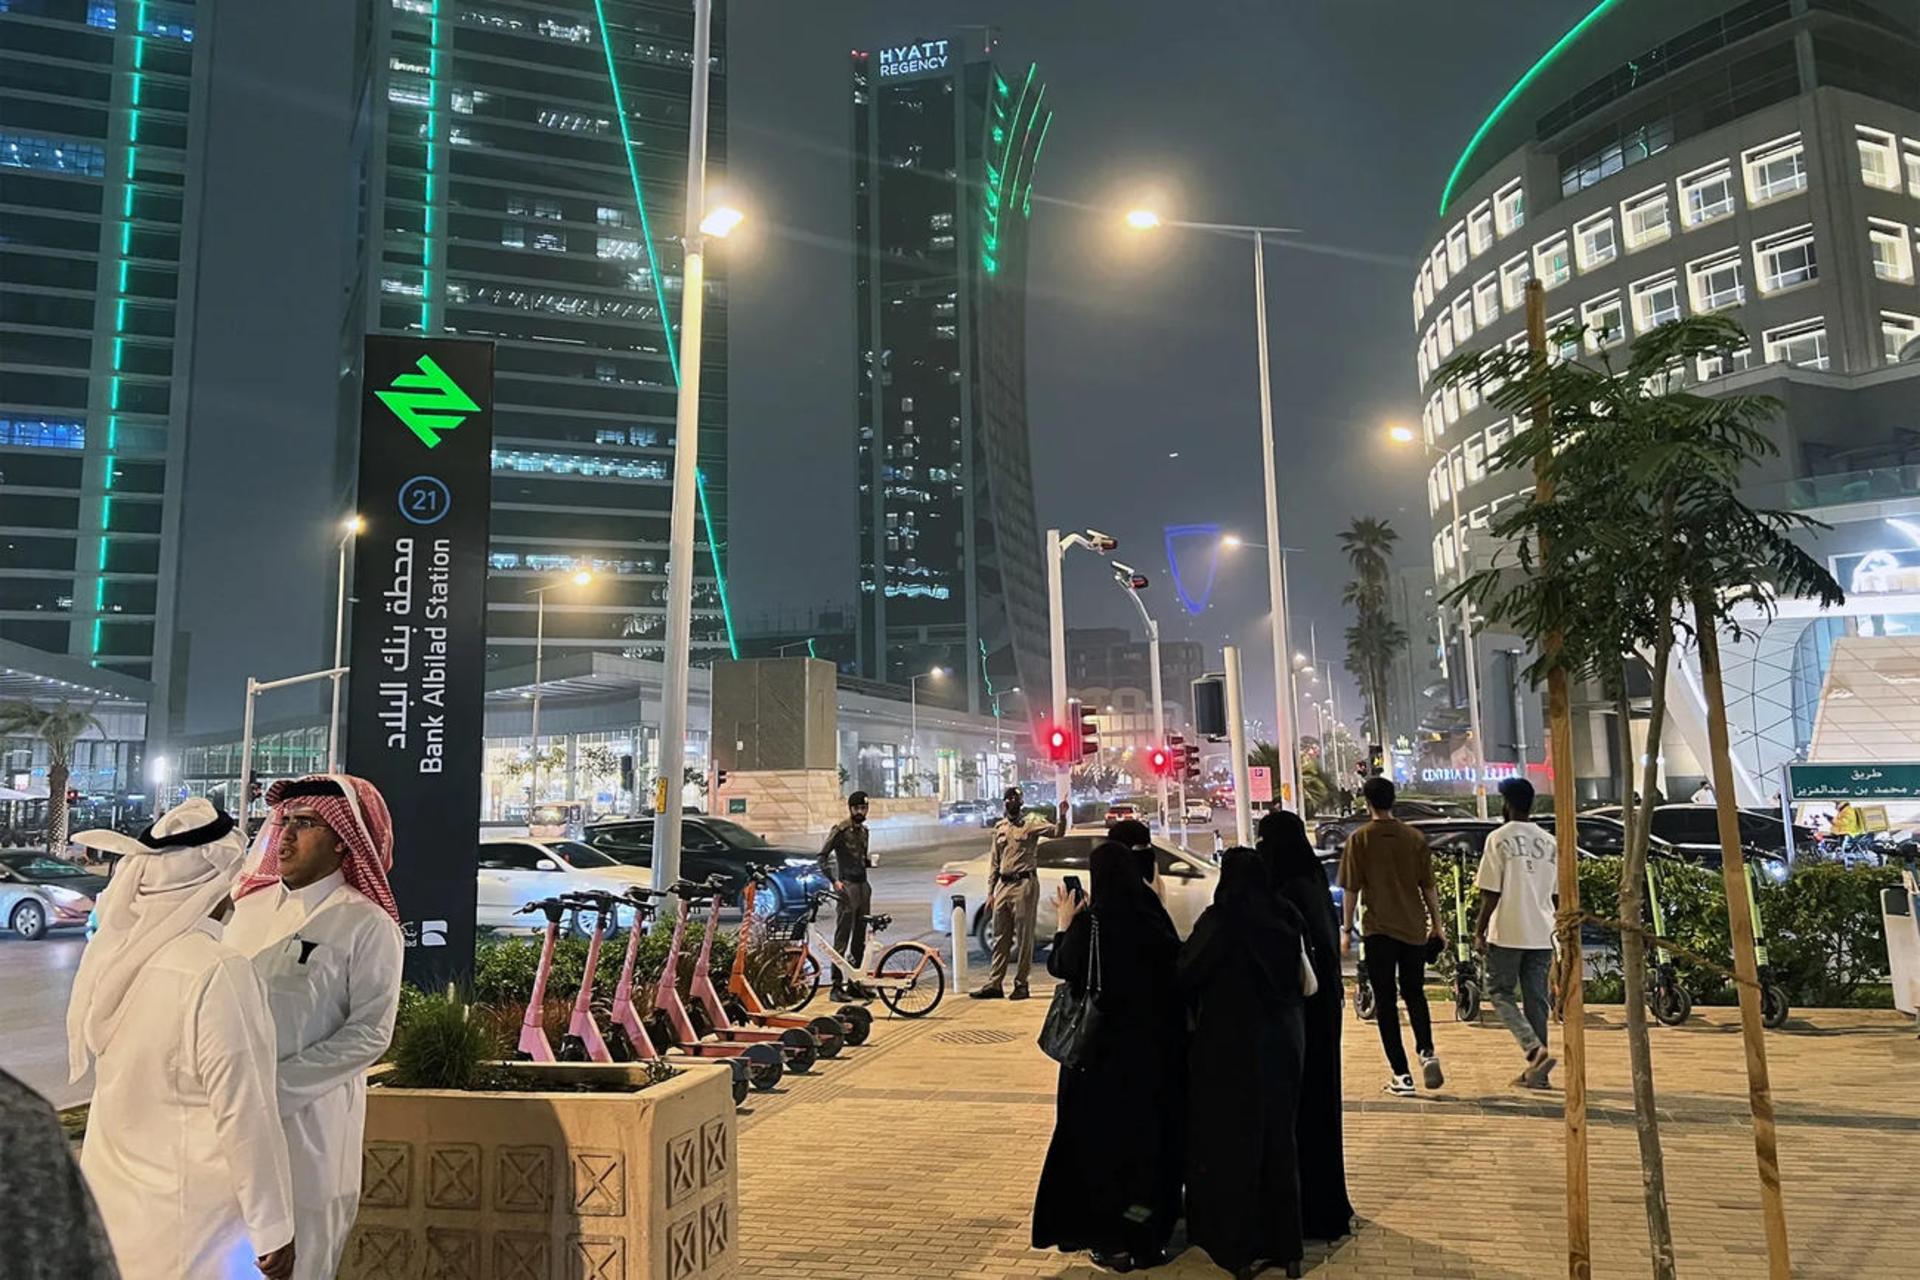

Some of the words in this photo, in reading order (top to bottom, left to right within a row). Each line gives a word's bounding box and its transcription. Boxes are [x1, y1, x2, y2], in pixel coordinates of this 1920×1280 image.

[880, 40, 948, 64] HYATT
[880, 55, 948, 77] REGENCY
[412, 489, 437, 511] 21
[383, 537, 414, 616] محطة
[425, 538, 451, 620] Station
[380, 625, 418, 672] بنك
[421, 627, 447, 708] Albilad
[378, 682, 415, 749] البلاد
[419, 714, 445, 774] Bank
[1851, 768, 1883, 781] طريق
[1854, 786, 1869, 796] بن
[1873, 785, 1908, 795] محمد
